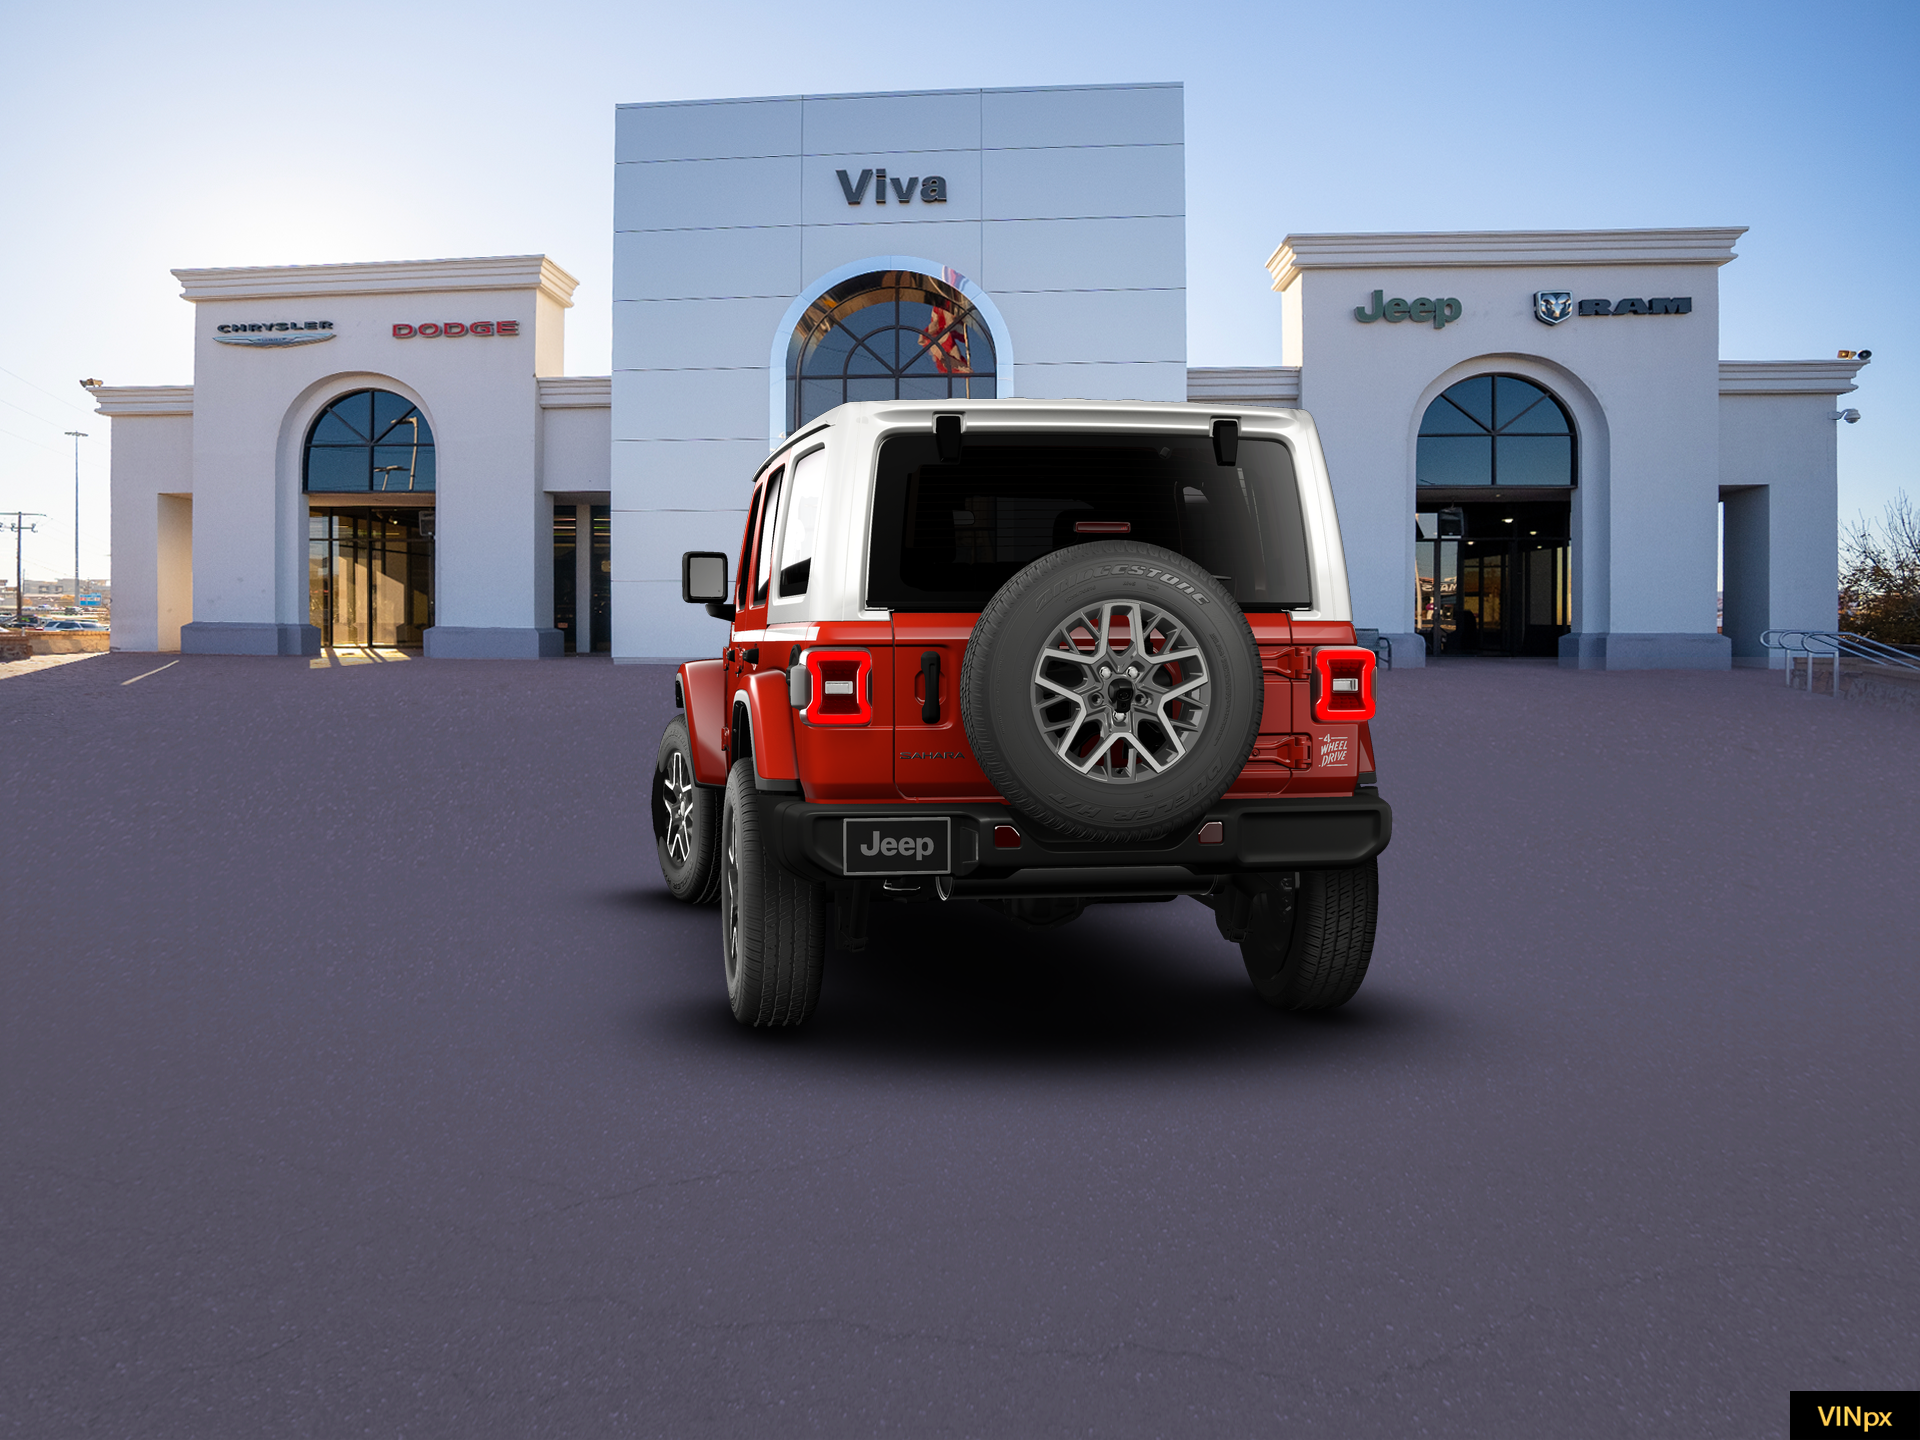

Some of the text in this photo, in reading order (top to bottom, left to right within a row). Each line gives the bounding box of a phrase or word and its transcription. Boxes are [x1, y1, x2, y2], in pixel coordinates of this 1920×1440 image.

[835, 168, 947, 205] Viva
[1354, 290, 1463, 329] Jeep
[1579, 297, 1692, 316] RAM
[216, 321, 334, 333] CHRYSLER
[392, 320, 520, 338] DODGE
[1036, 564, 1211, 613] BRIDGESTONE
[1323, 734, 1331, 743] 4
[1321, 741, 1348, 755] WHEEL
[1321, 751, 1348, 767] DRIVE
[860, 831, 935, 861] Jeep
